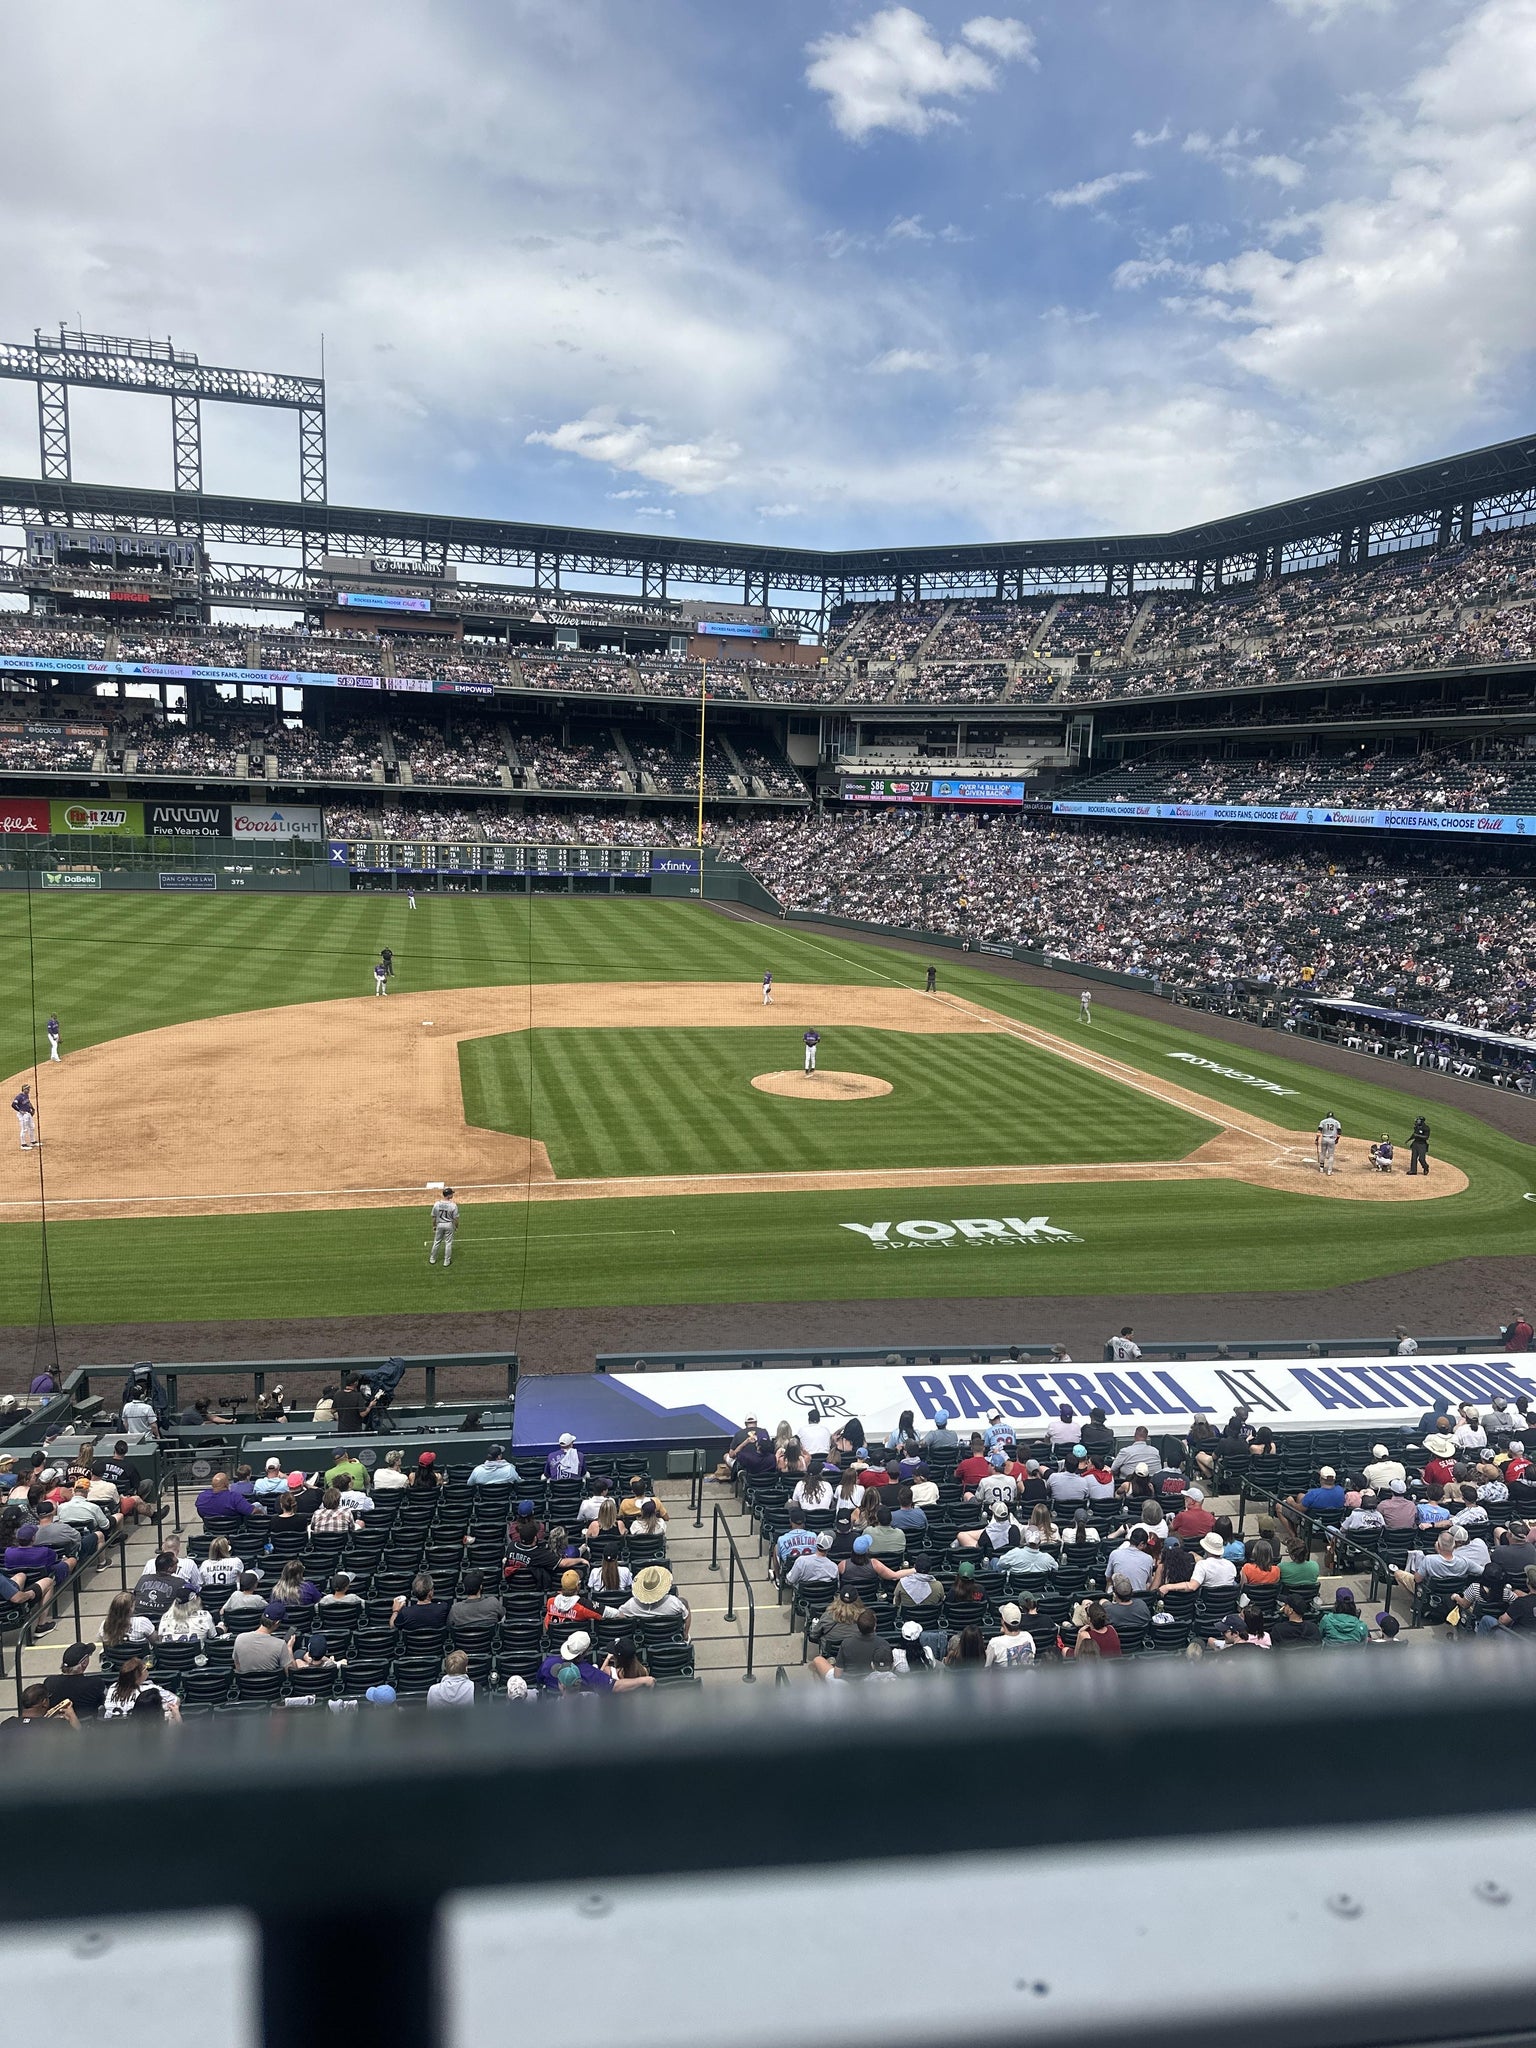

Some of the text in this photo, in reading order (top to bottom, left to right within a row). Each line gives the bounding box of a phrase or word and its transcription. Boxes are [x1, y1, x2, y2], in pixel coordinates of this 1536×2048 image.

[26, 531, 195, 561] THE ROOFTOP
[548, 613, 580, 626] Silver
[4, 660, 34, 668] ROCKIES
[87, 664, 108, 672] Chill
[192, 669, 220, 677] ROCKIES
[221, 671, 240, 679] FANS,
[241, 672, 267, 680] CHOOSE
[455, 685, 492, 694] EMPOWER
[871, 781, 884, 790] $86
[911, 782, 929, 792] $277
[101, 811, 125, 823] 24/7
[153, 807, 219, 823] ARROW
[1214, 810, 1297, 821] ROCKIES FANS, CHOOSE Chill
[1354, 816, 1374, 824] LIGHT
[234, 816, 318, 833] Coors LIGHT
[1385, 816, 1503, 830] ROCKIES FANS, CHOOSE Chill
[153, 826, 220, 836] Five Years Out
[660, 860, 691, 873] xfinity
[64, 875, 96, 883] DaBella
[1326, 1123, 1334, 1131] 12
[439, 1210, 448, 1218] 71
[838, 1216, 1074, 1241] YORK
[872, 1235, 1085, 1250] SPACE SYSTEMS
[1119, 1347, 1124, 1359] 6
[902, 1361, 1536, 1420] BASEBALL AT ALTITUDE
[992, 1486, 1012, 1501] 93
[509, 1552, 531, 1565] FLORES
[212, 1572, 227, 1584] 19
